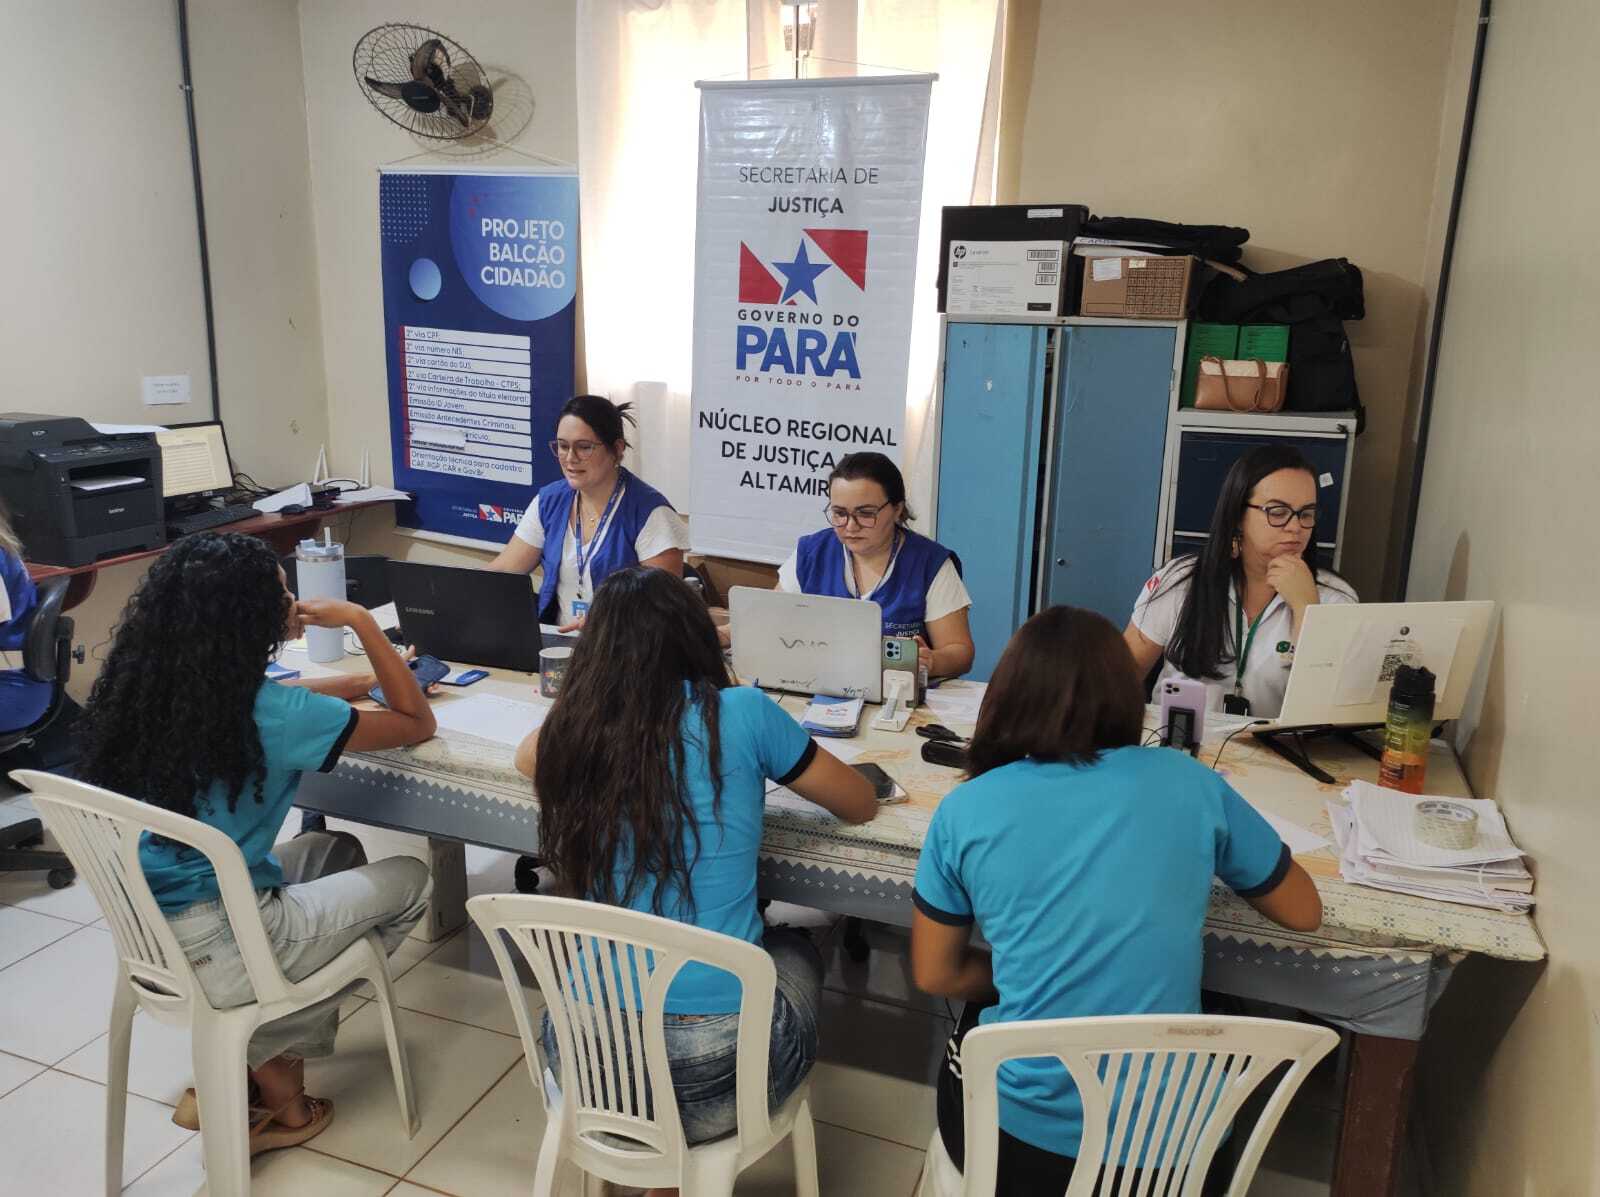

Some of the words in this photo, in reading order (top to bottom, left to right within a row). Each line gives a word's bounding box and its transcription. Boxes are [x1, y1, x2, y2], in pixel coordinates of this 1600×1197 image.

[739, 166, 848, 184] SECRETARIA
[854, 167, 880, 184] DE
[768, 197, 844, 218] JUSTIÇA
[481, 218, 565, 240] PROJETO
[489, 240, 565, 265] BALCÃO
[480, 265, 566, 289] CIDADÃO
[738, 309, 823, 325] GOVERNO
[833, 314, 859, 327] DO
[426, 345, 450, 354] número
[736, 325, 862, 379] PARÁ
[427, 359, 449, 367] cartão
[428, 373, 454, 383] Carteira
[455, 376, 463, 384] de
[464, 377, 495, 386] Trabalho
[736, 375, 760, 383] POR
[769, 377, 803, 386] TODO
[811, 380, 817, 388] O
[827, 382, 861, 391] PARÁ
[428, 385, 467, 397] informações
[409, 397, 435, 407] Emissão
[410, 411, 435, 420] Emissão
[437, 414, 481, 426] Antecedentes
[699, 408, 781, 435] NÚCLEO
[787, 419, 897, 447] REGIONAL
[411, 450, 448, 463] Orientação
[449, 454, 473, 465] técnica
[473, 460, 490, 469] para
[721, 441, 746, 459] DE
[752, 444, 836, 472] JUSTIÇA
[740, 471, 830, 498] ALTAMIR
[503, 512, 524, 525] PAR
